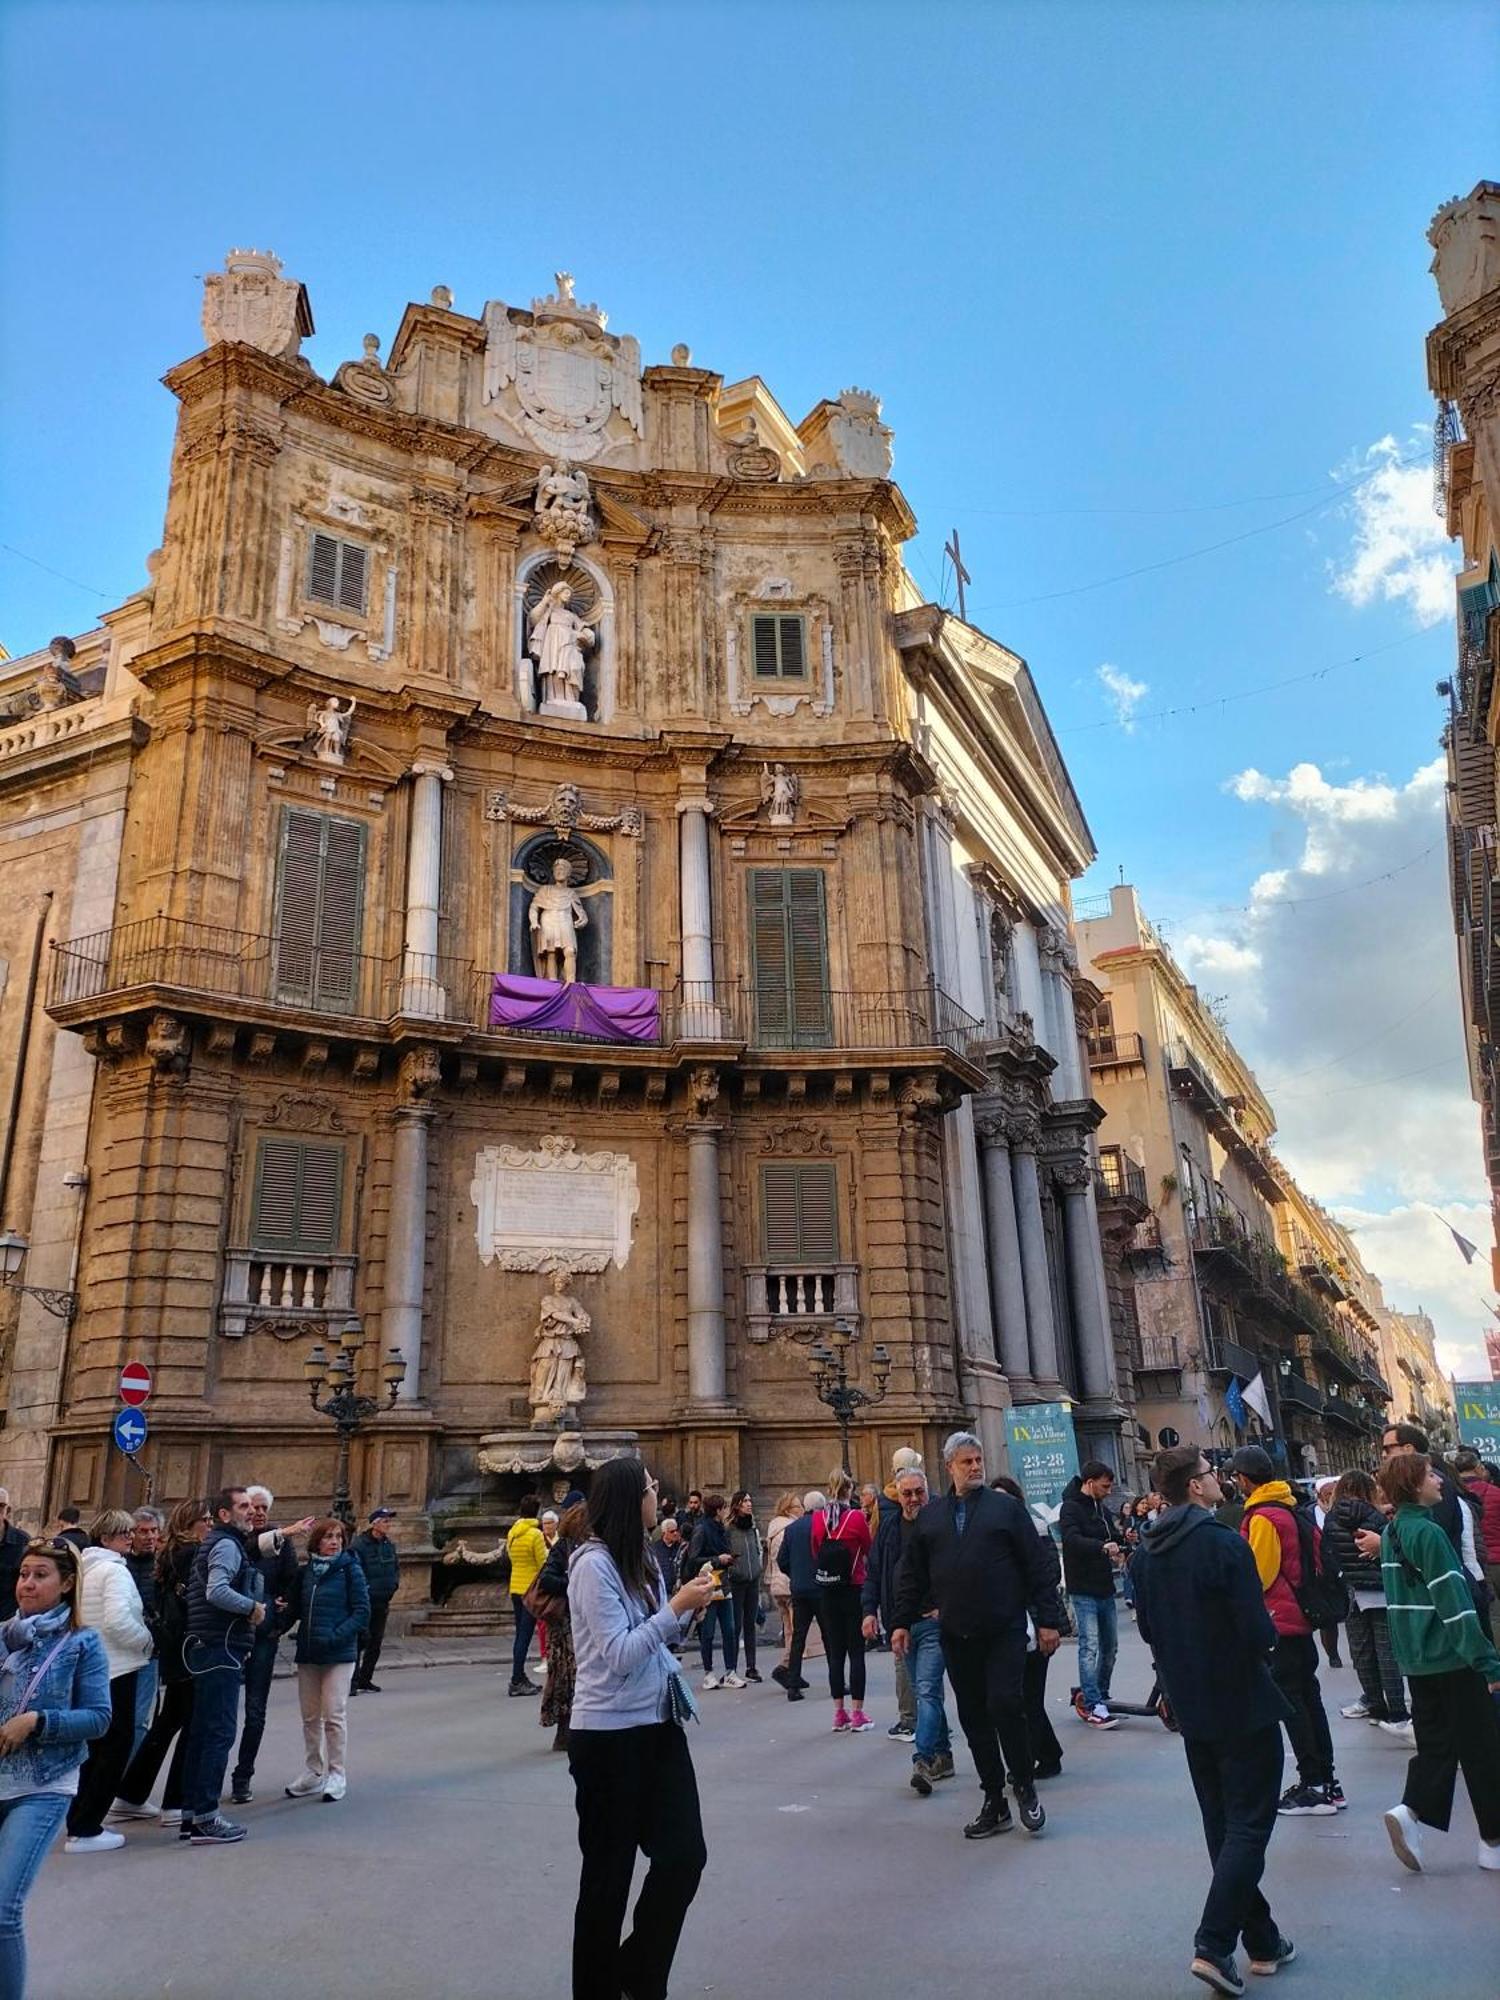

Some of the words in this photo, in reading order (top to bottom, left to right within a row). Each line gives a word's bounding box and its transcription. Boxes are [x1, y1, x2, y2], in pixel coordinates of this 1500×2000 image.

[1464, 1404, 1486, 1419] IX
[1014, 1427, 1031, 1440] IX
[1023, 1453, 1064, 1468] 23-28
